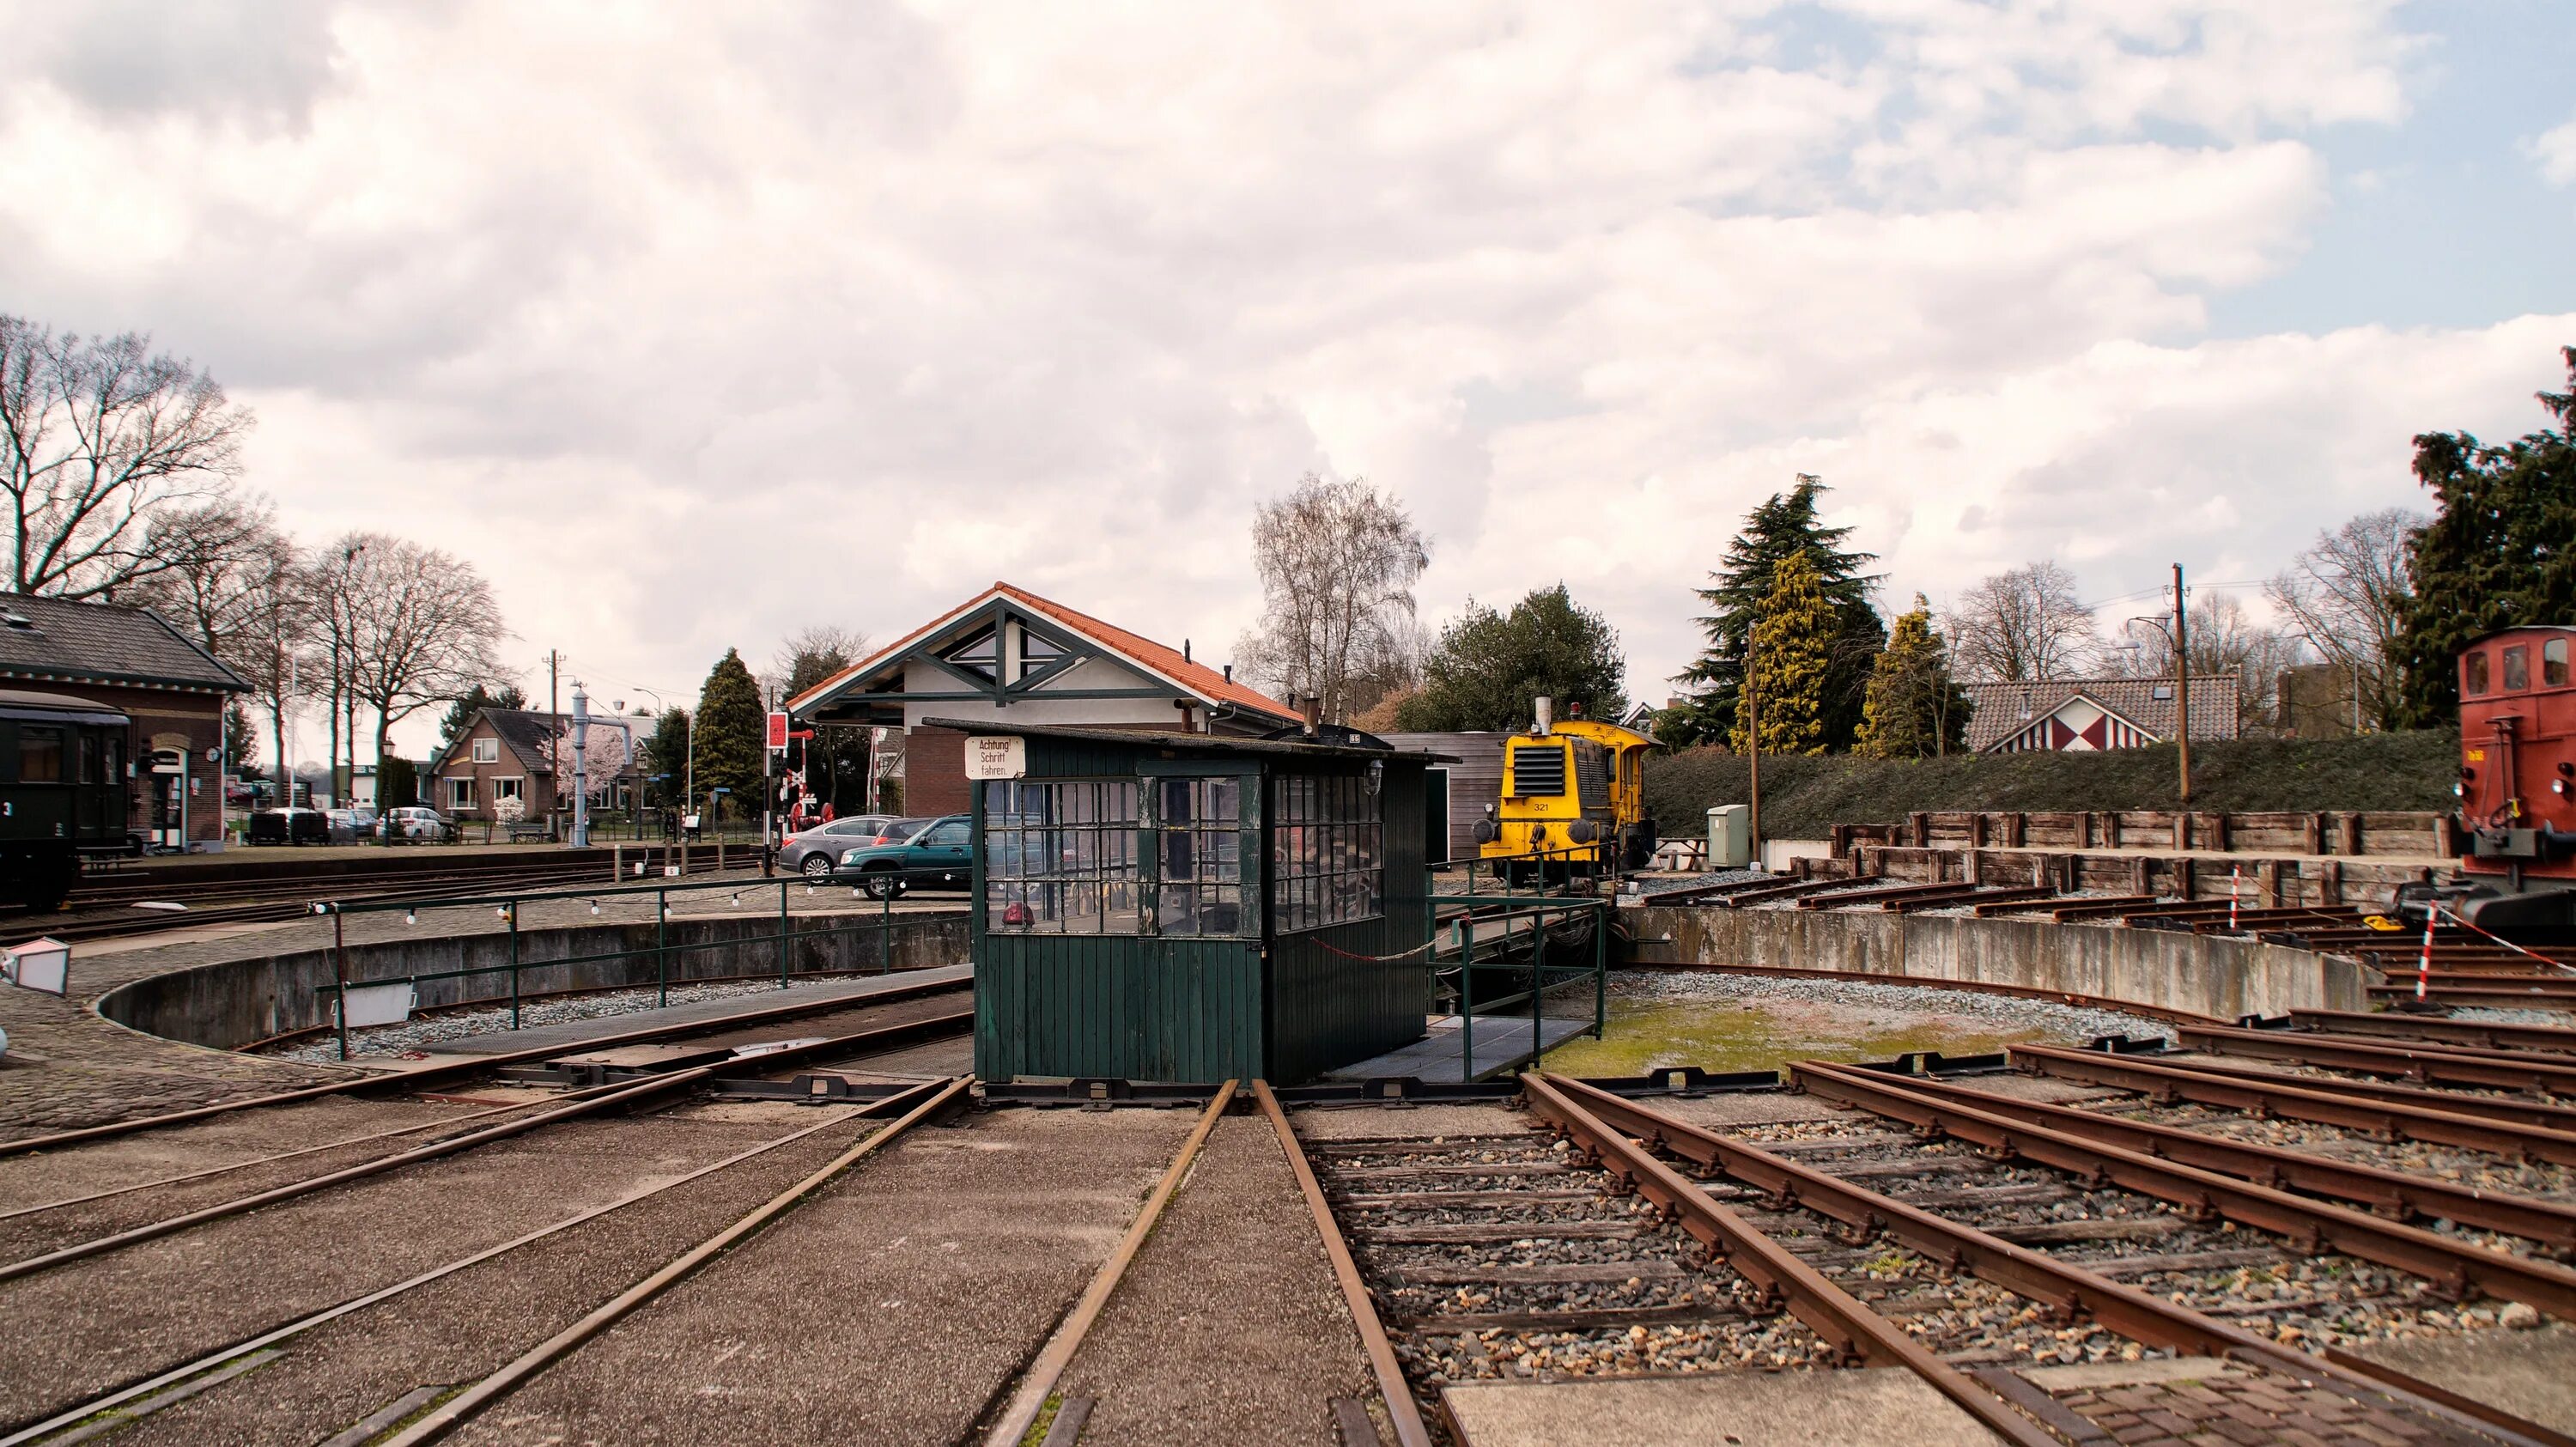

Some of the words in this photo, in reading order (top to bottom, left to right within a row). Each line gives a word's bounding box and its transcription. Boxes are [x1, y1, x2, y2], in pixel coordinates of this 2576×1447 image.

[979, 739, 1011, 752] Achtung!
[981, 752, 1005, 763] Schritt
[981, 765, 1008, 775] fahren.
[3, 801, 13, 817] 3
[1534, 803, 1548, 812] 321
